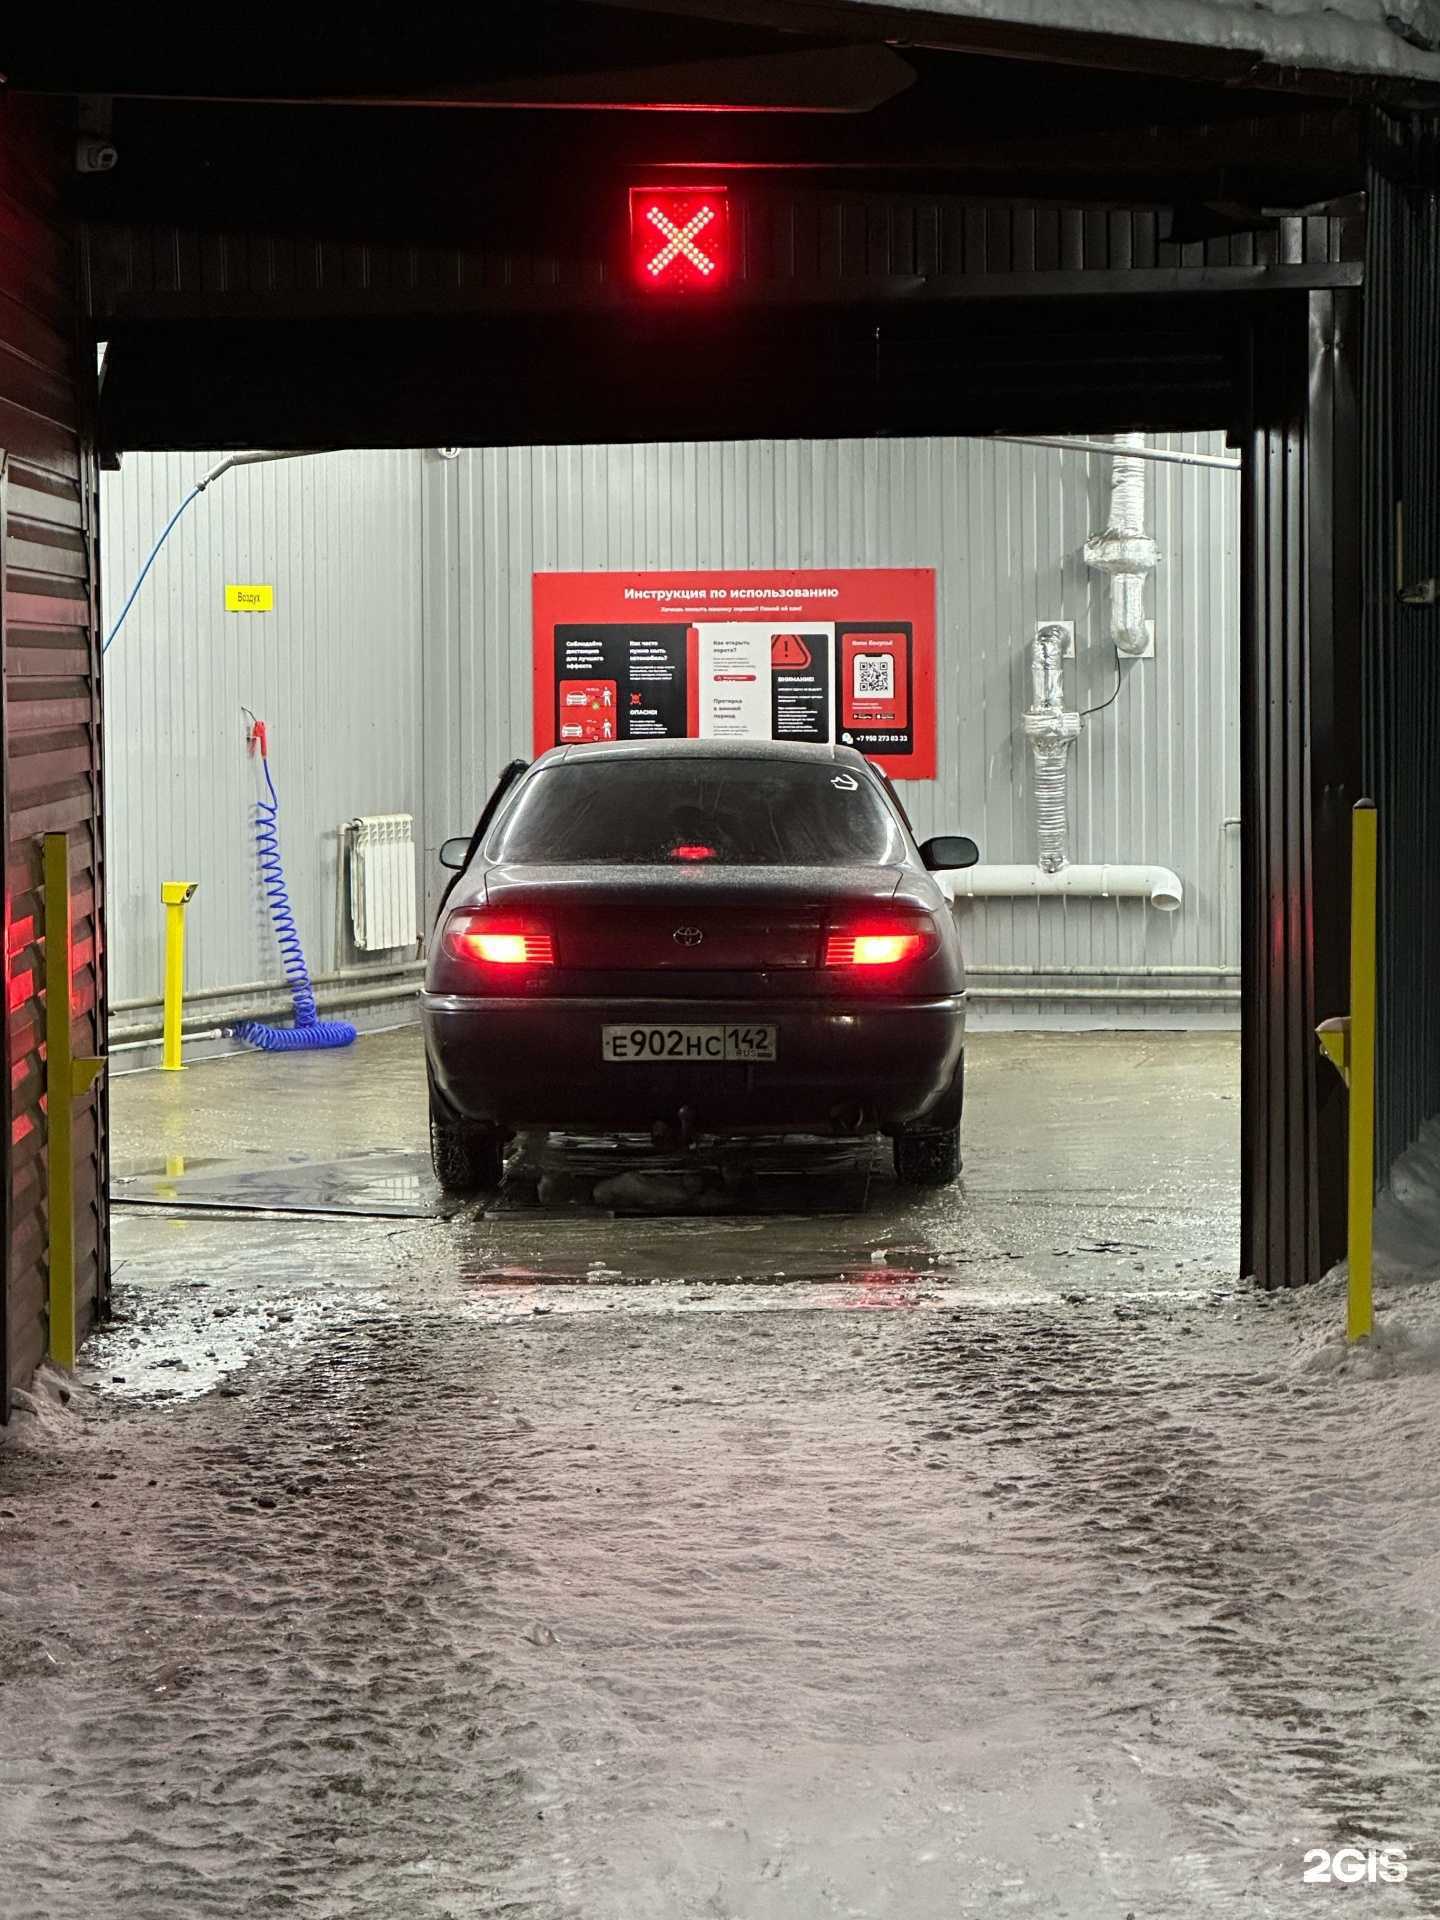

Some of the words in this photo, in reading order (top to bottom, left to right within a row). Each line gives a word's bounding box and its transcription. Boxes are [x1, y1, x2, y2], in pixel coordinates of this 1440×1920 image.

[237, 591, 261, 605] Воздух
[624, 588, 707, 602] Инструкция
[710, 589, 727, 598] по
[730, 588, 839, 599] использованию
[725, 640, 751, 648] открыть
[612, 1029, 722, 1057] Е902НС
[728, 1029, 768, 1050] 142
